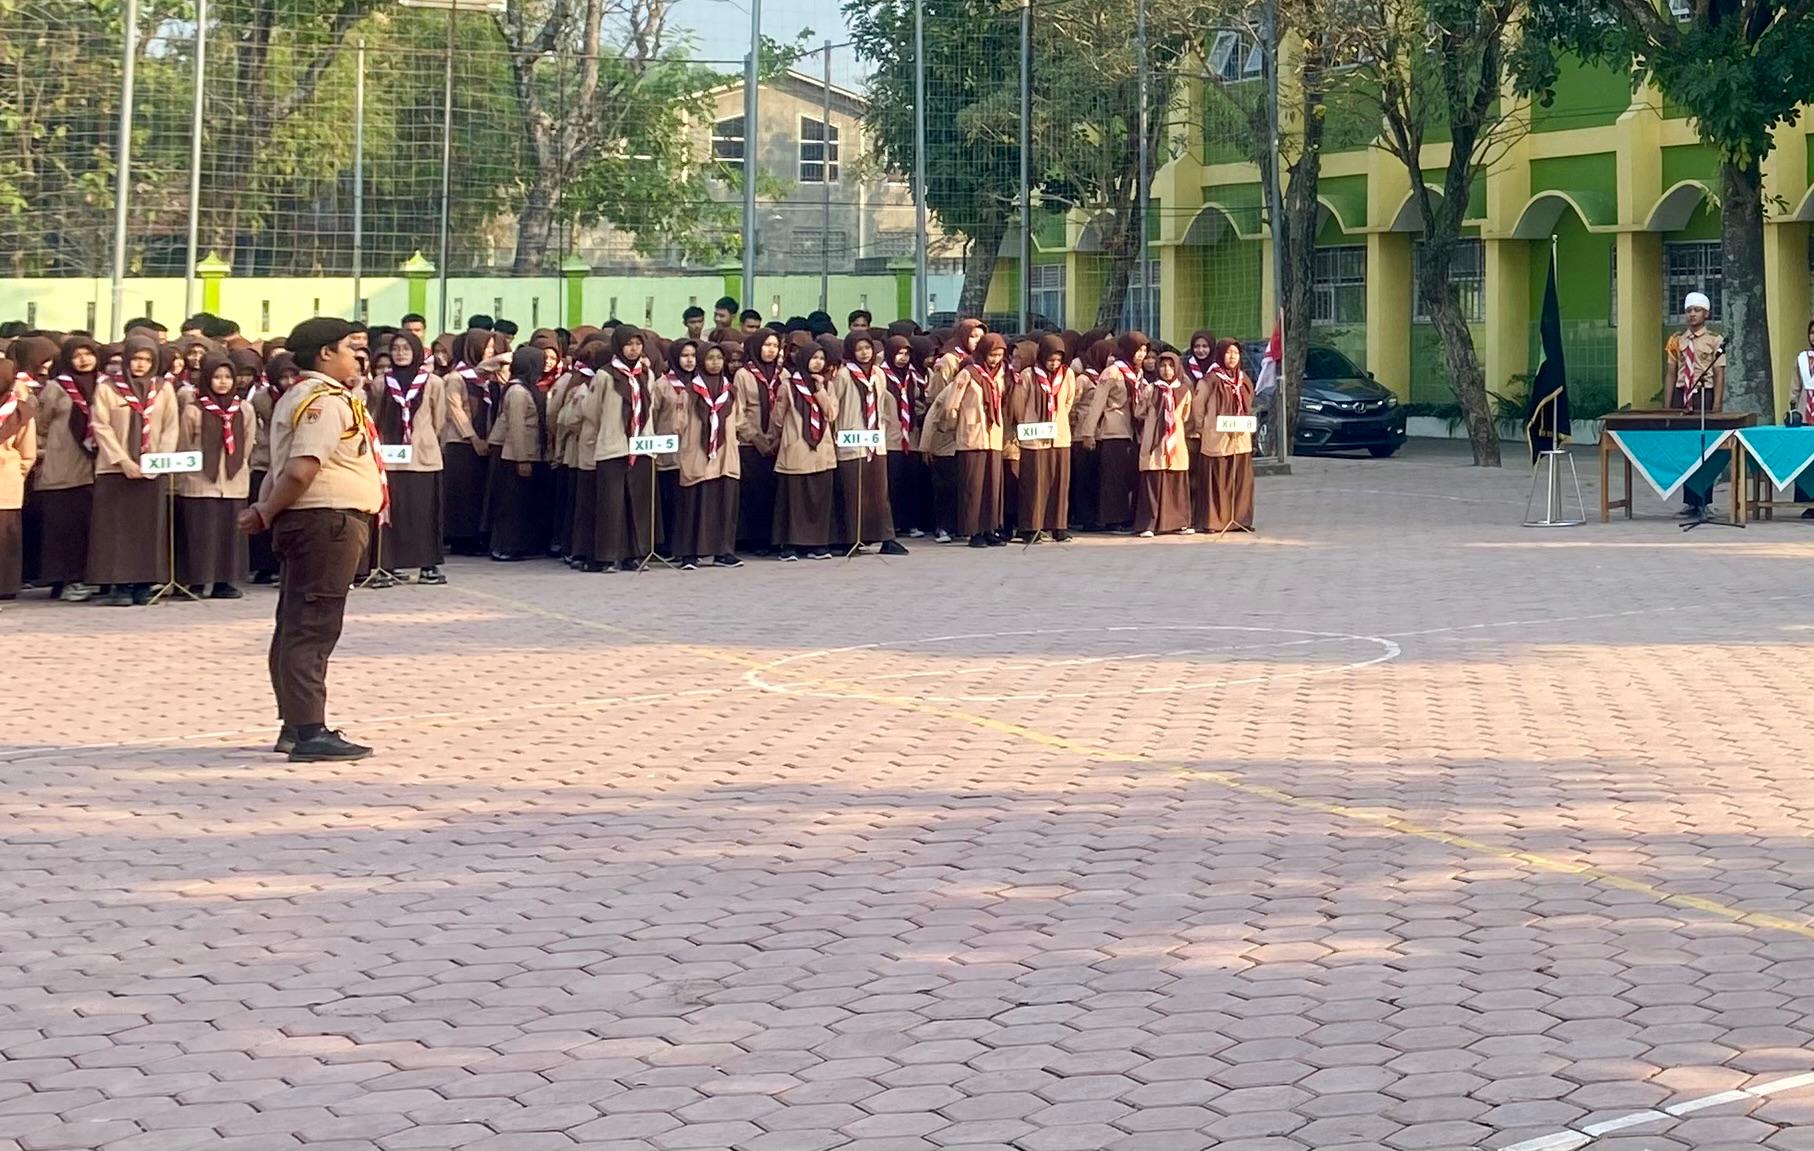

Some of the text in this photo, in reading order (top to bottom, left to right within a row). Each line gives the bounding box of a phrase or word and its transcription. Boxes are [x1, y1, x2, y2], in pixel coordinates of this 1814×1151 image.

[1023, 427, 1038, 437] XII
[1048, 425, 1054, 434] 7
[635, 439, 653, 450] XII
[666, 438, 674, 449] 5
[843, 433, 860, 444] XII
[872, 433, 880, 444] 6
[397, 448, 406, 459] 4
[149, 457, 171, 469] XII
[186, 455, 196, 467] 3
